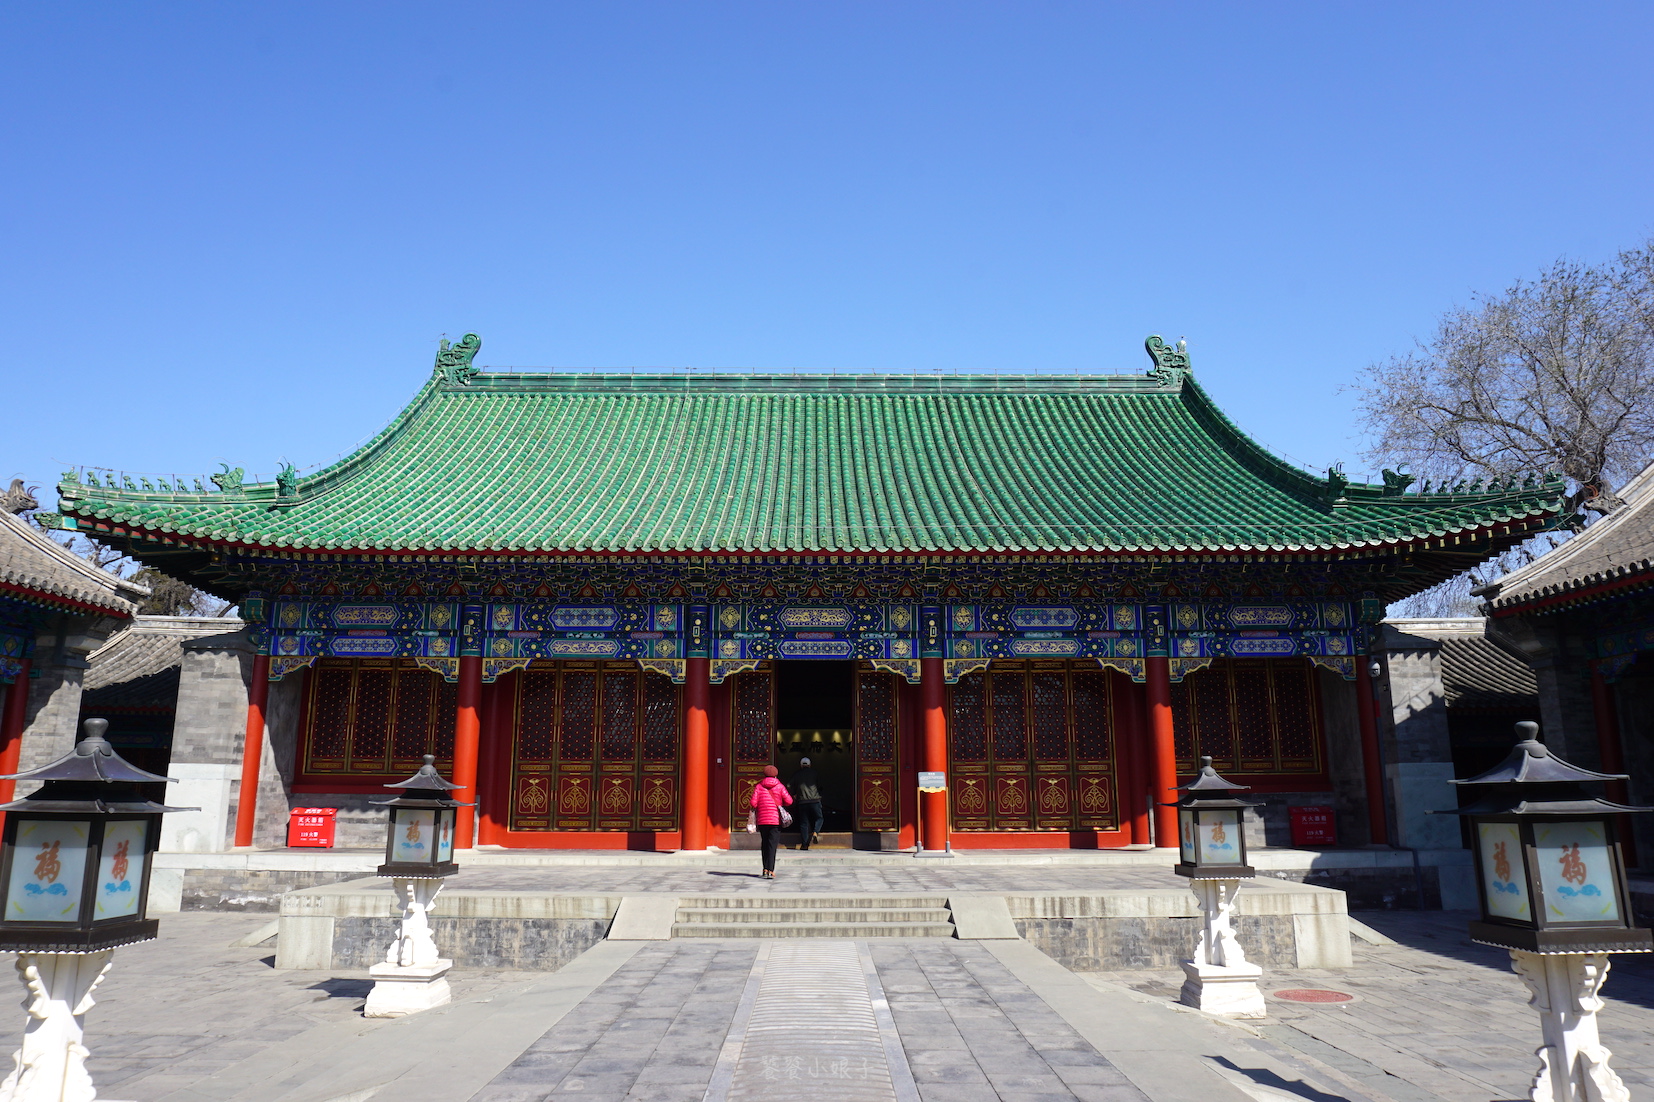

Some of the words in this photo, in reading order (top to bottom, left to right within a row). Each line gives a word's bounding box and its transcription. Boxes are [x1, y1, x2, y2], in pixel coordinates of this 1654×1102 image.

[406, 819, 421, 843] 福
[1211, 820, 1226, 844] 福
[33, 839, 62, 884] 福
[111, 839, 130, 882] 福
[1492, 840, 1512, 883] 福
[1559, 841, 1588, 885] 福
